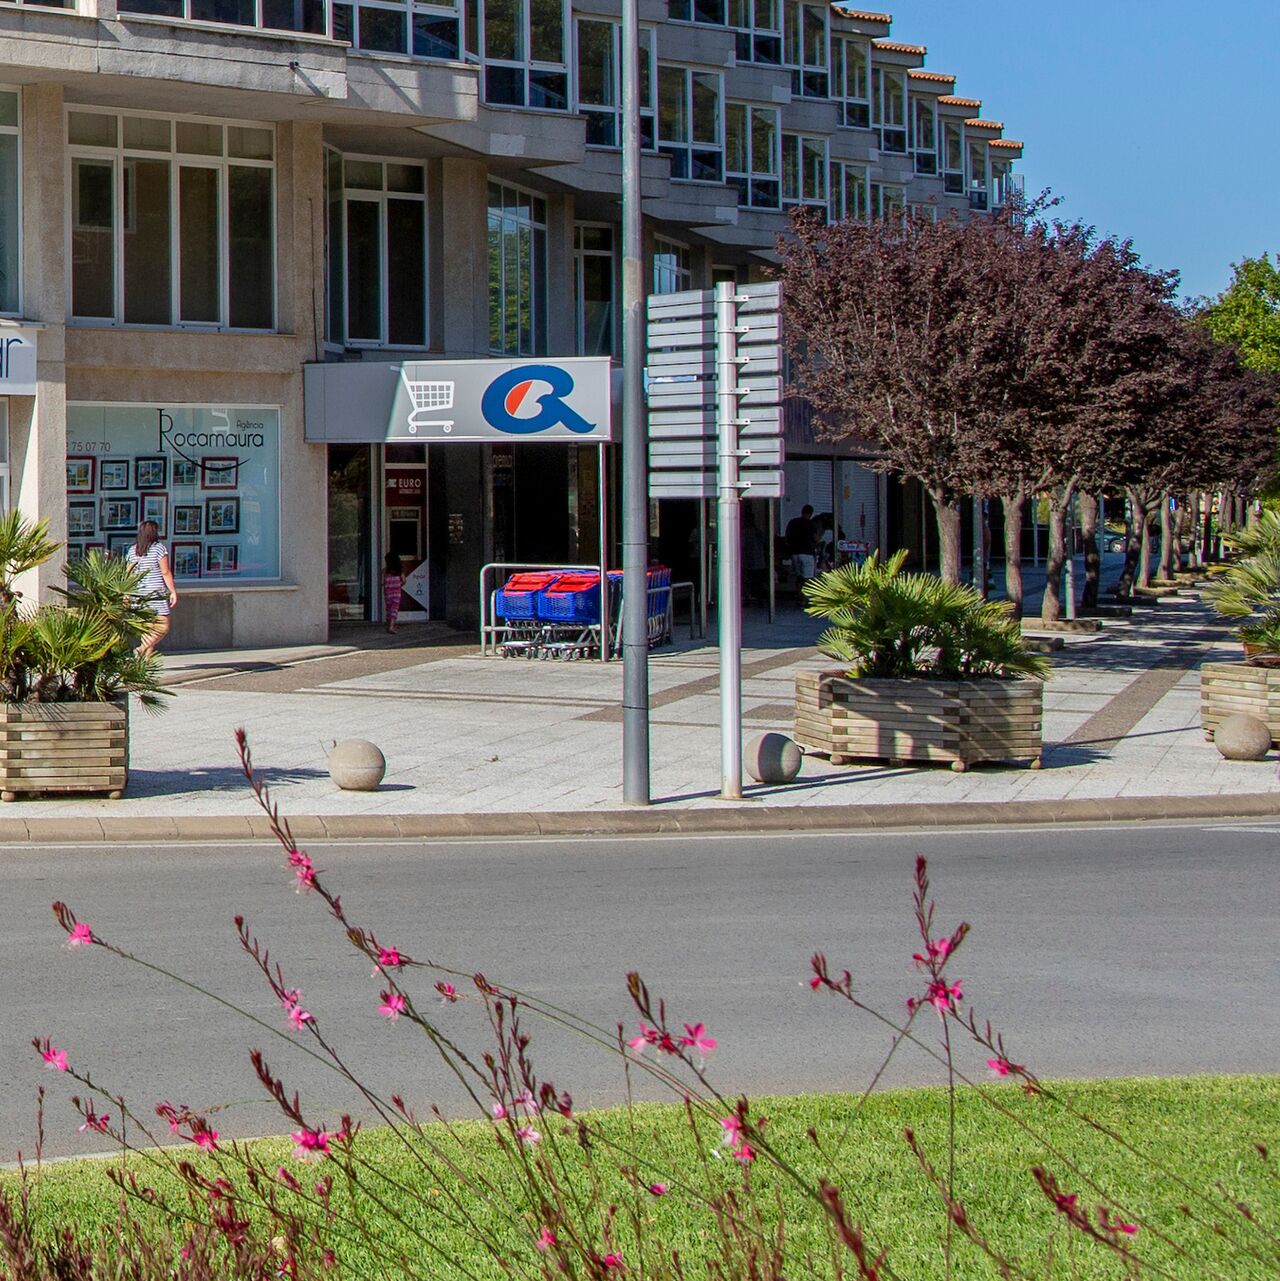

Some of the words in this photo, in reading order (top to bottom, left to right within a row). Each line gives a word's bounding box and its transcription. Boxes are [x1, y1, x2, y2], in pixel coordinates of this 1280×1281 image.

[157, 408, 264, 458] Rocamaura
[71, 441, 83, 451] 75
[85, 441, 97, 451] 07
[99, 441, 111, 452] 70
[398, 478, 422, 488] EURO
